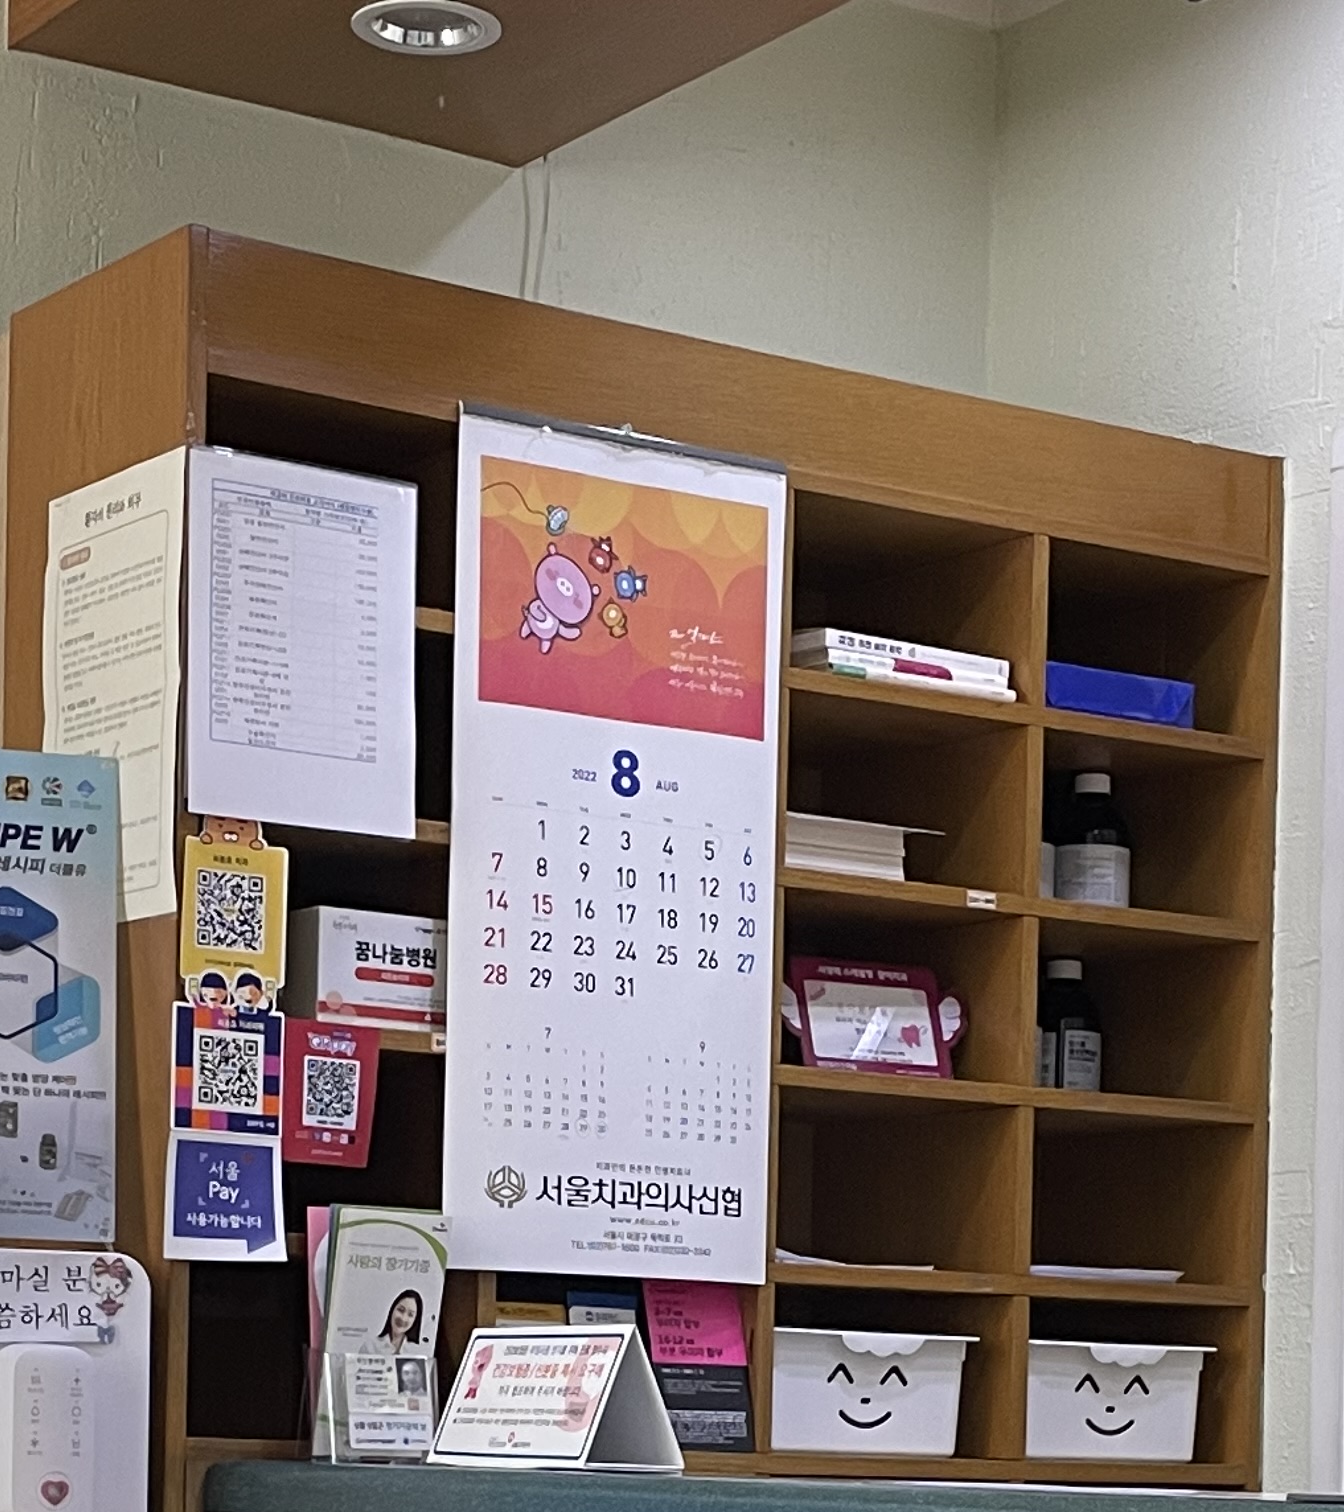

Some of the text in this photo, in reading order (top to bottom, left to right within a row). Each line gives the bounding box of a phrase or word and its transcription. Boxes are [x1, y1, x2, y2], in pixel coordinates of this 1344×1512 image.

[572, 750, 678, 797] 2022 8 AUG
[538, 820, 752, 866] 1 2 3 4 5 6
[492, 852, 755, 903] 7 8 9 10 11 12 13
[487, 889, 755, 938] 14 15 16 17 18 19 20
[355, 940, 437, 969] 꿈나눔병원
[484, 927, 754, 973] 21 22 23 24 25 26 27
[484, 964, 633, 996] 28 29 30 31
[545, 1027, 552, 1039] 7
[699, 1041, 706, 1053] 9
[209, 1161, 240, 1182] 서울
[209, 1181, 239, 1203] Pay
[535, 1174, 742, 1218] 서울치과의사신협
[186, 1212, 262, 1229] 사용가능합니다
[347, 1254, 431, 1273] 사랑의 장기기증
[0, 1265, 50, 1292] 마실
[62, 1266, 87, 1290] 분
